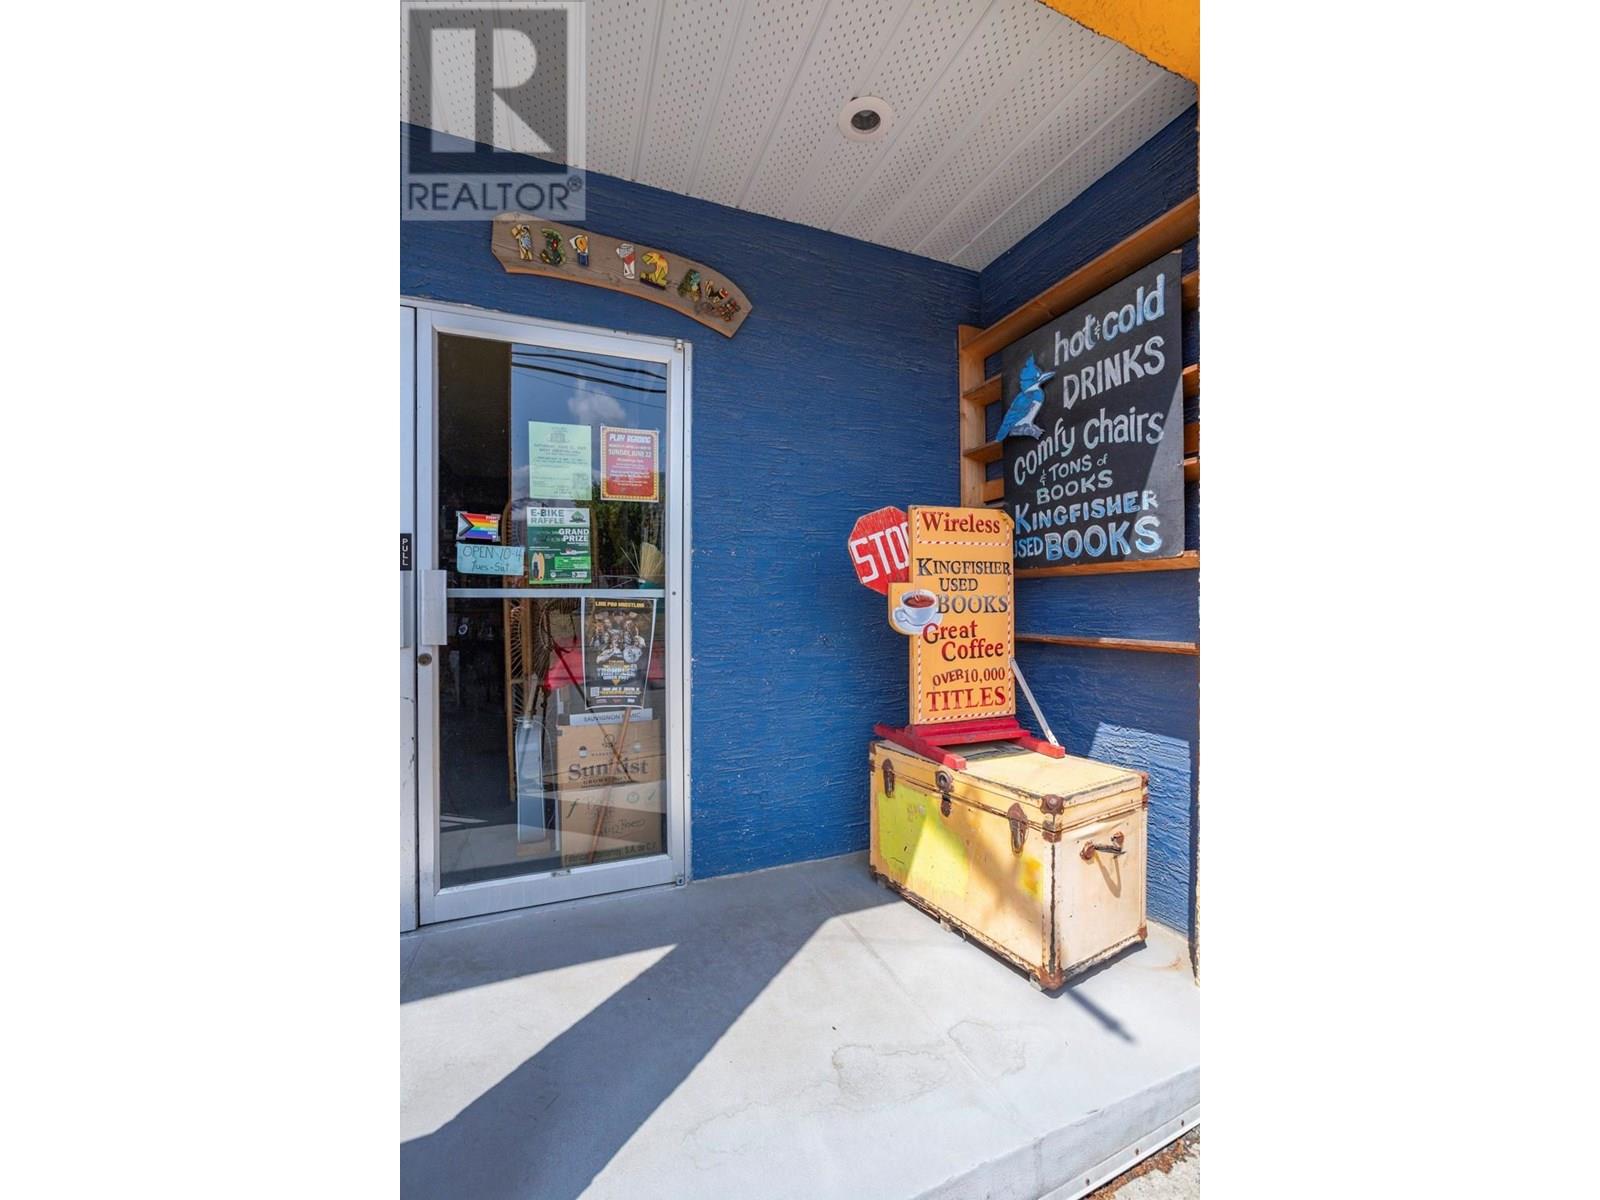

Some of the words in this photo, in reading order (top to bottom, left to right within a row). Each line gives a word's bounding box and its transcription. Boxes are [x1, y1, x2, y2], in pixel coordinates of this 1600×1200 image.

[1054, 314, 1096, 366] hot
[1102, 273, 1165, 341] cold
[1063, 335, 1165, 410] DRINKS
[1048, 454, 1093, 481] TONS
[1096, 453, 1108, 466] of
[1036, 469, 1113, 505] BOOKS
[530, 508, 565, 518] E-BIKE
[921, 511, 1001, 534] Wireless
[1015, 490, 1159, 534] KINGFISHER
[1045, 515, 1162, 561] BOOKS
[401, 538, 409, 566] PULL
[463, 545, 494, 559] OPEN
[916, 558, 1012, 577] KINGFISHER
[939, 577, 979, 592] USED
[935, 594, 1009, 614] BOOKS
[922, 619, 979, 644] Great
[941, 638, 1004, 662] Coffee
[932, 668, 964, 687] OVER
[964, 667, 1006, 684] 10,000
[926, 686, 1007, 713] TITLES
